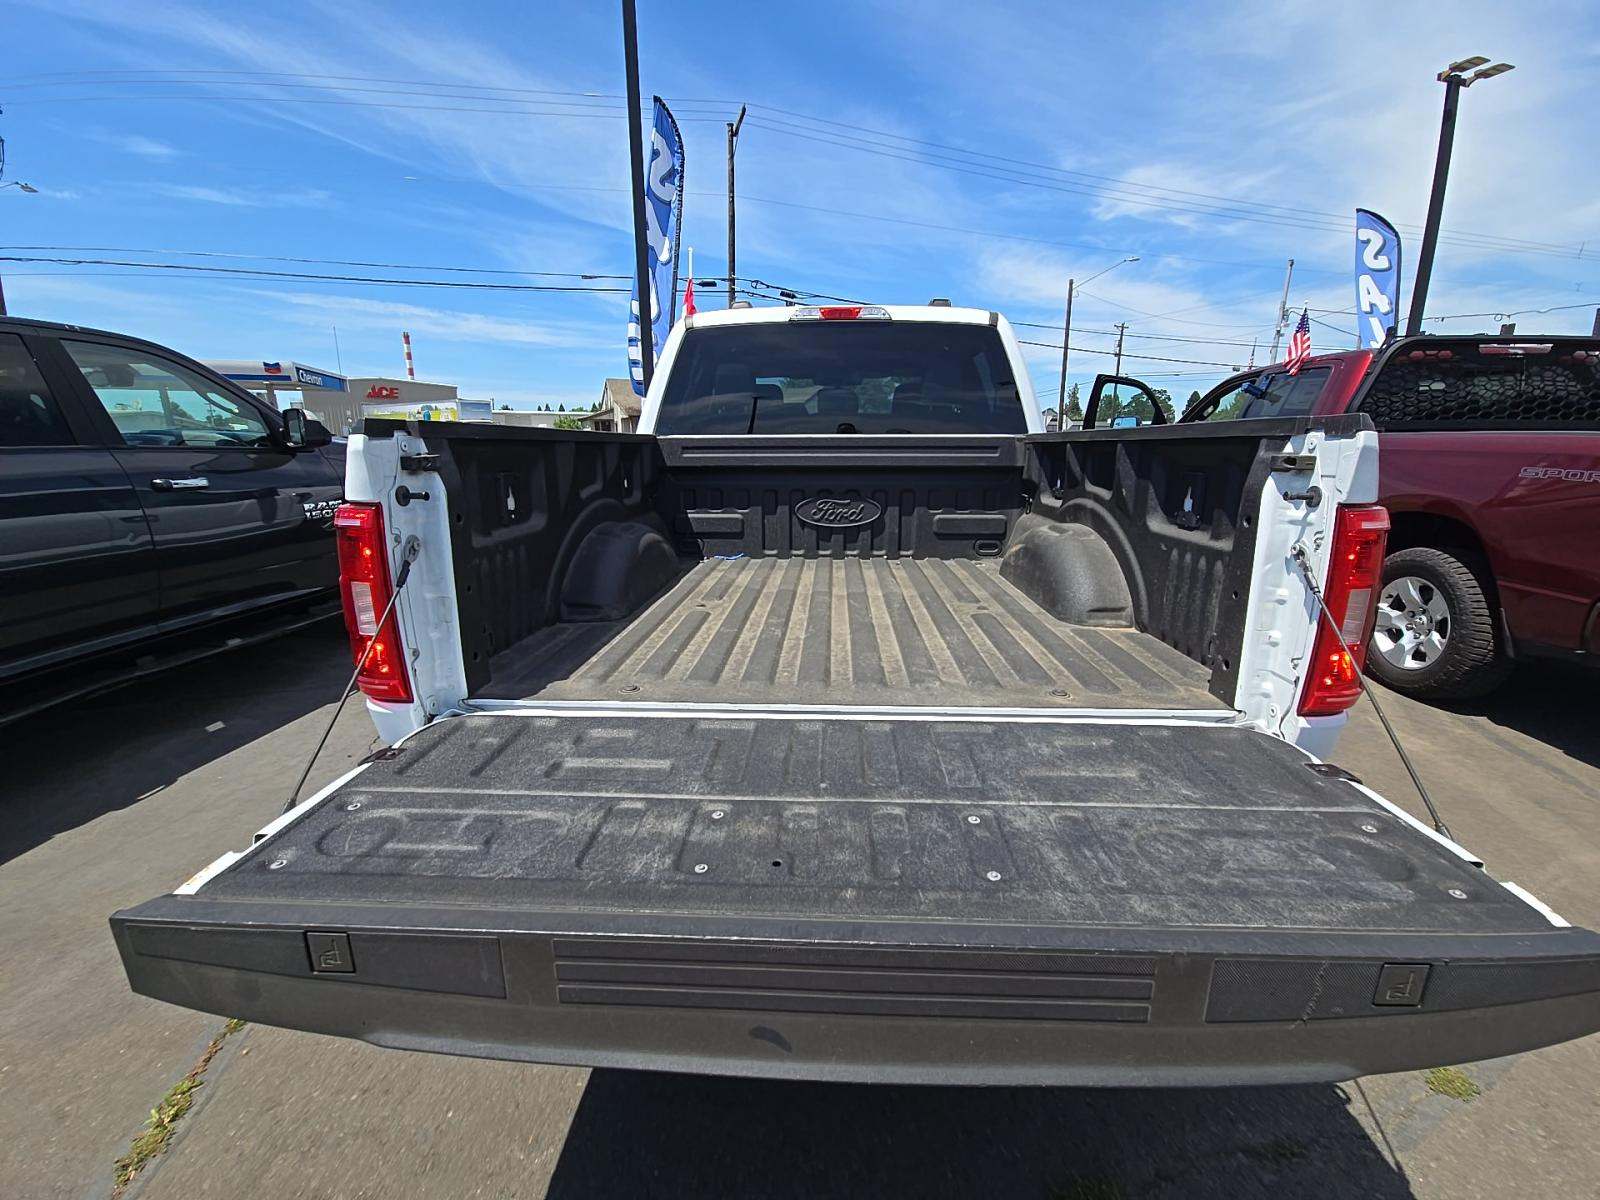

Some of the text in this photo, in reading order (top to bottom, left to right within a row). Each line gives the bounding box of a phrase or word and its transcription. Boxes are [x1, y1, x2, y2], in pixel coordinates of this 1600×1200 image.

[299, 369, 324, 387] Chevron
[366, 383, 399, 399] ACE
[810, 499, 865, 521] Ford
